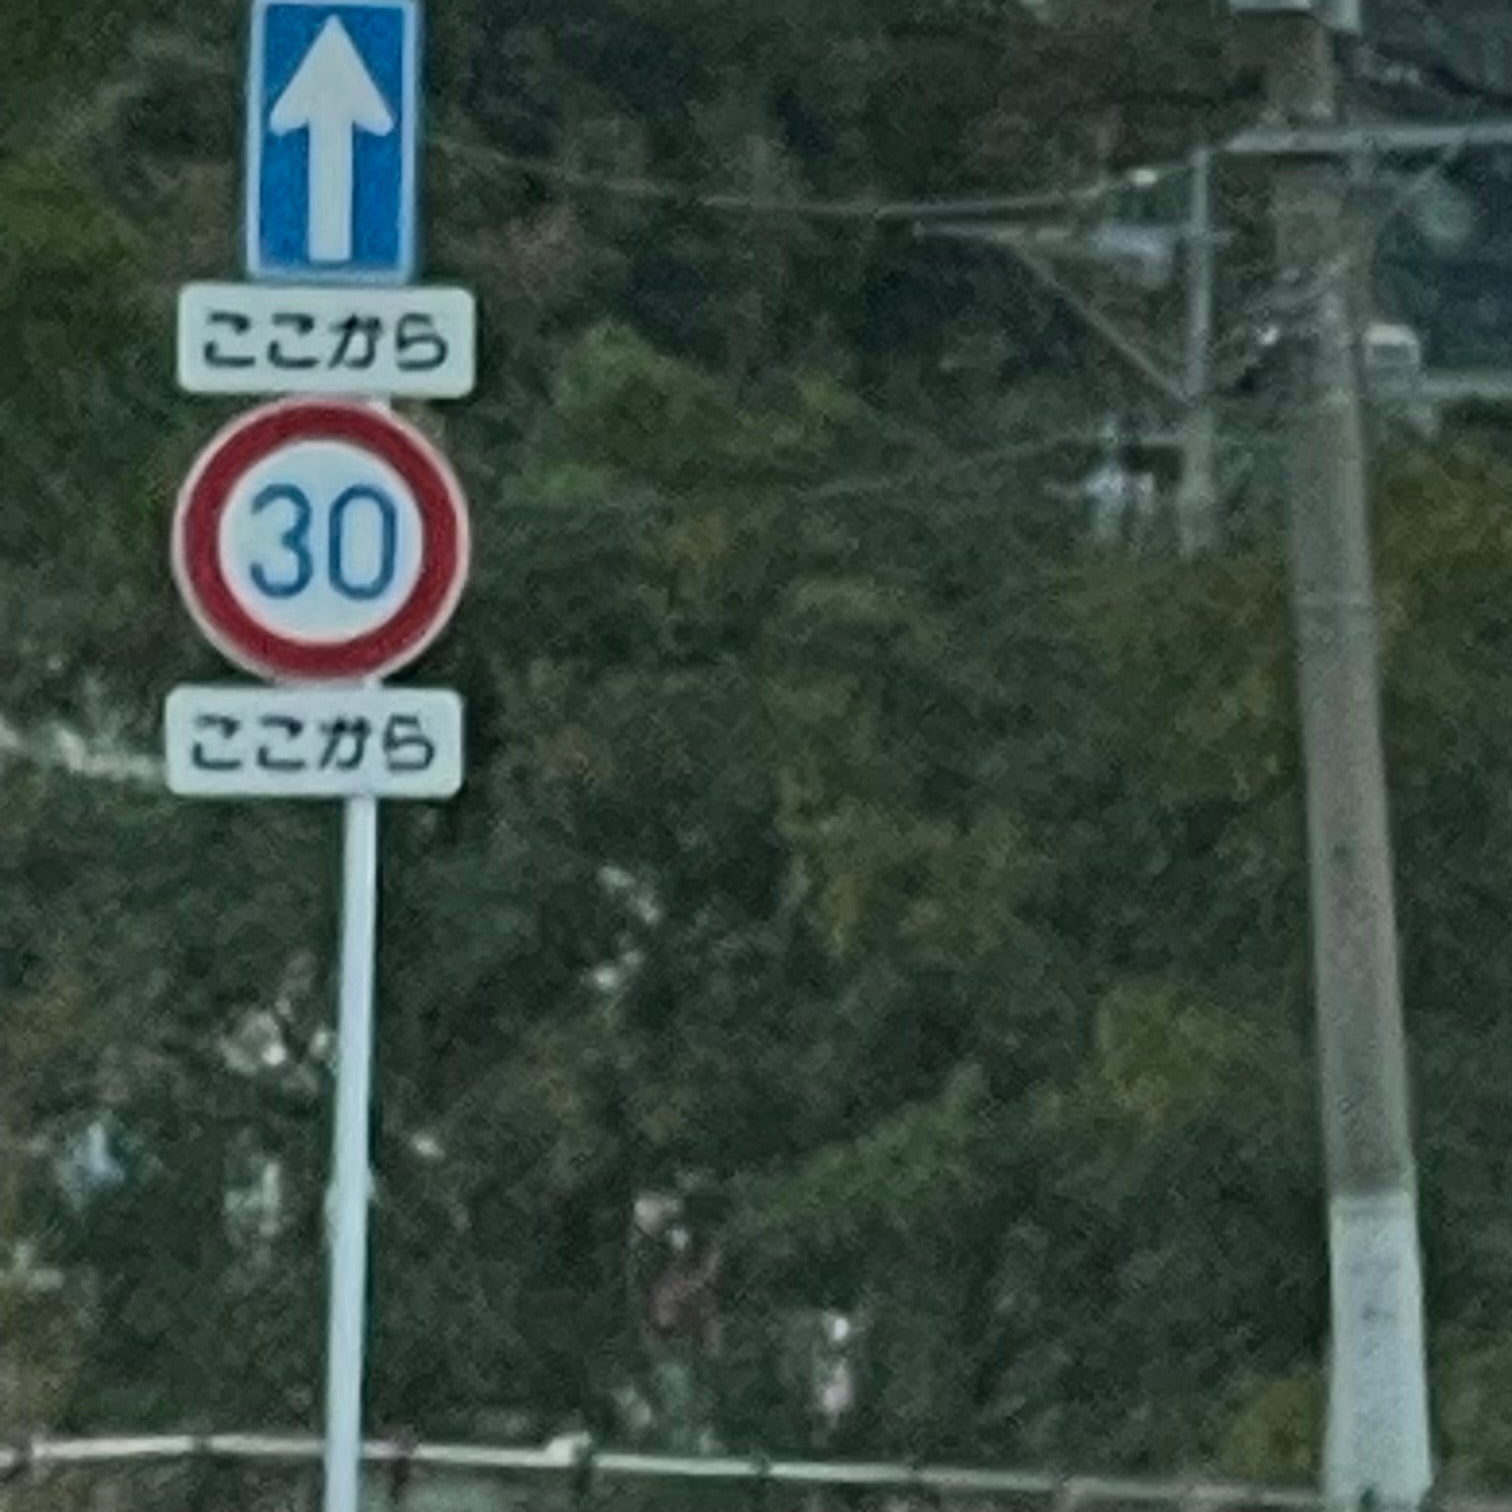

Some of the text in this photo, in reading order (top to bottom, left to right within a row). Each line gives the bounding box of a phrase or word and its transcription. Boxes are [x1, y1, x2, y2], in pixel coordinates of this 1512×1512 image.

[202, 314, 448, 370] ここから
[249, 485, 396, 601] 30
[190, 717, 436, 772] ここから
